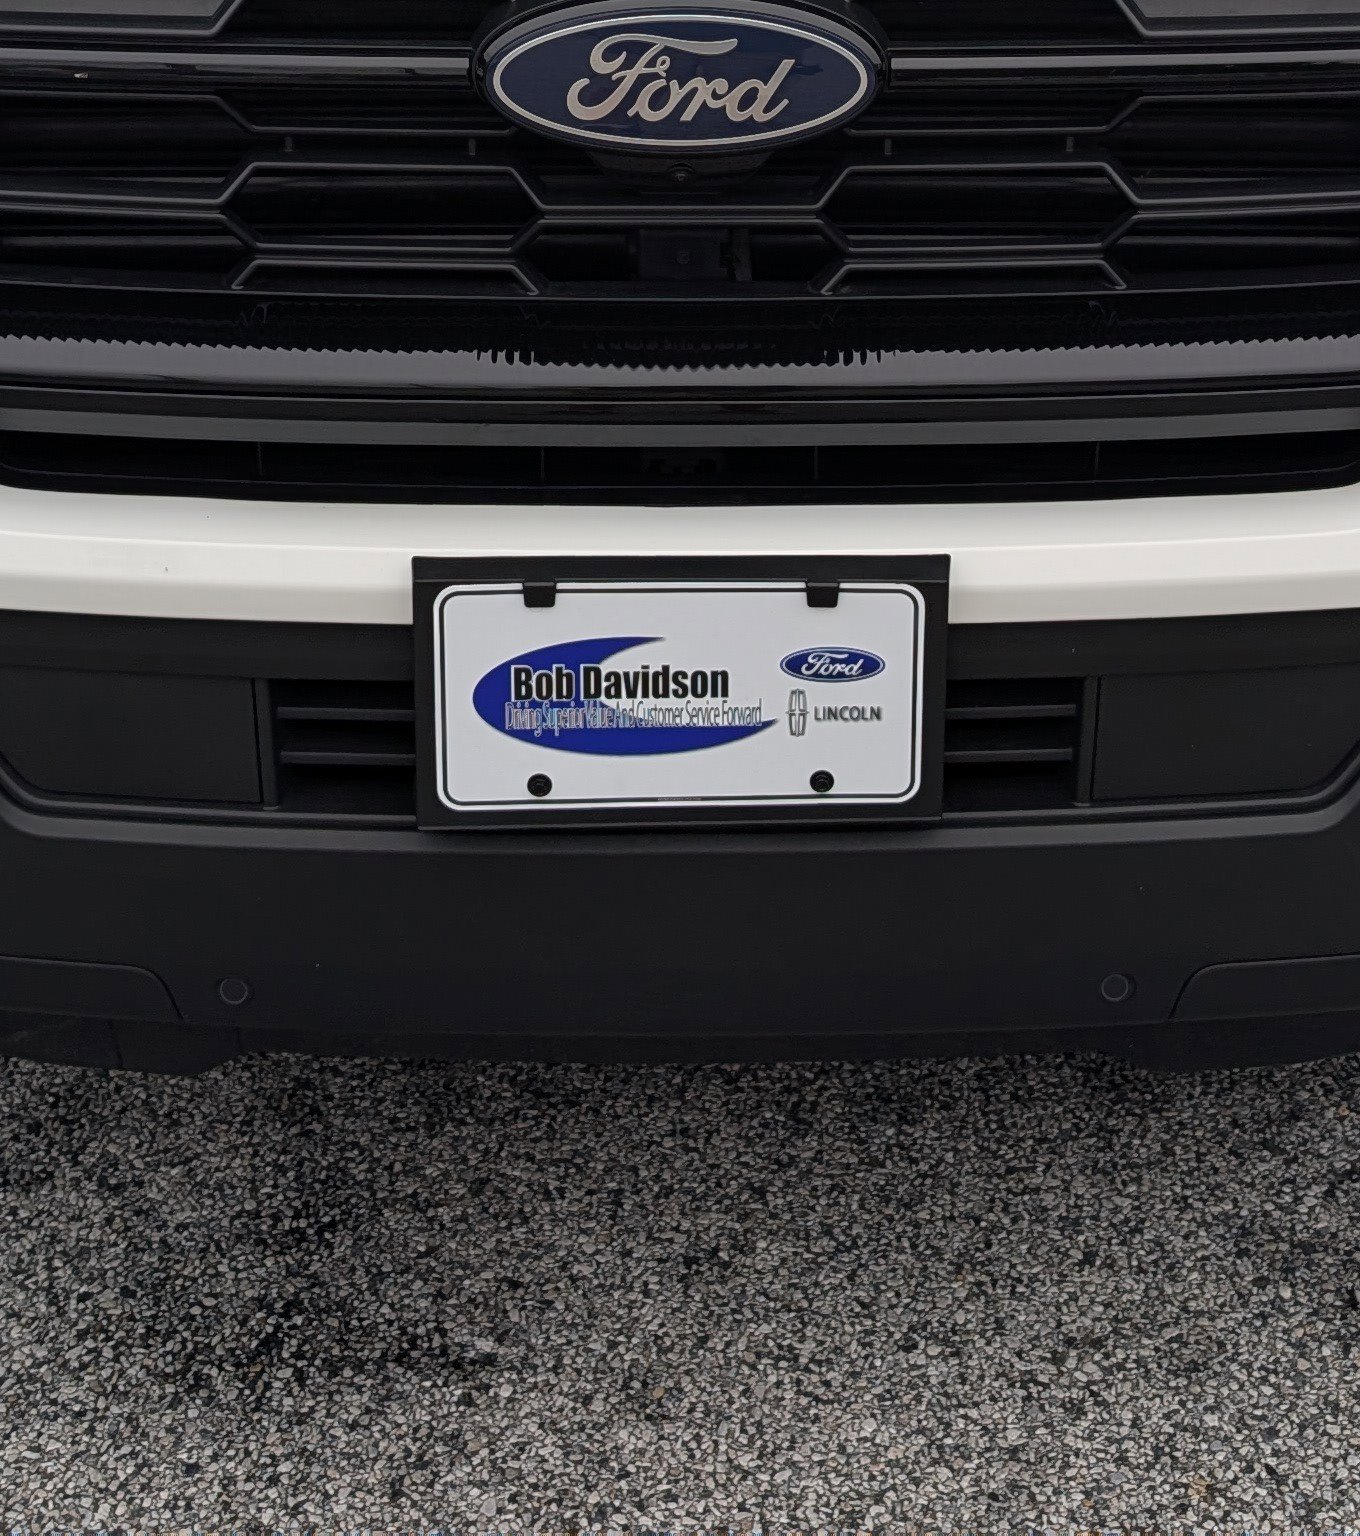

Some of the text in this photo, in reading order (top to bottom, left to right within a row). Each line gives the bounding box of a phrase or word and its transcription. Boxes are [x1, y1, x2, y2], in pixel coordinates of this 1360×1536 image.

[566, 33, 796, 123] Ford
[800, 652, 865, 676] Ford
[511, 664, 730, 702] Bob Davidson
[635, 699, 685, 728] Customer
[685, 699, 721, 727] Service
[721, 698, 763, 727] Forward
[814, 706, 882, 722] LINCOLN
